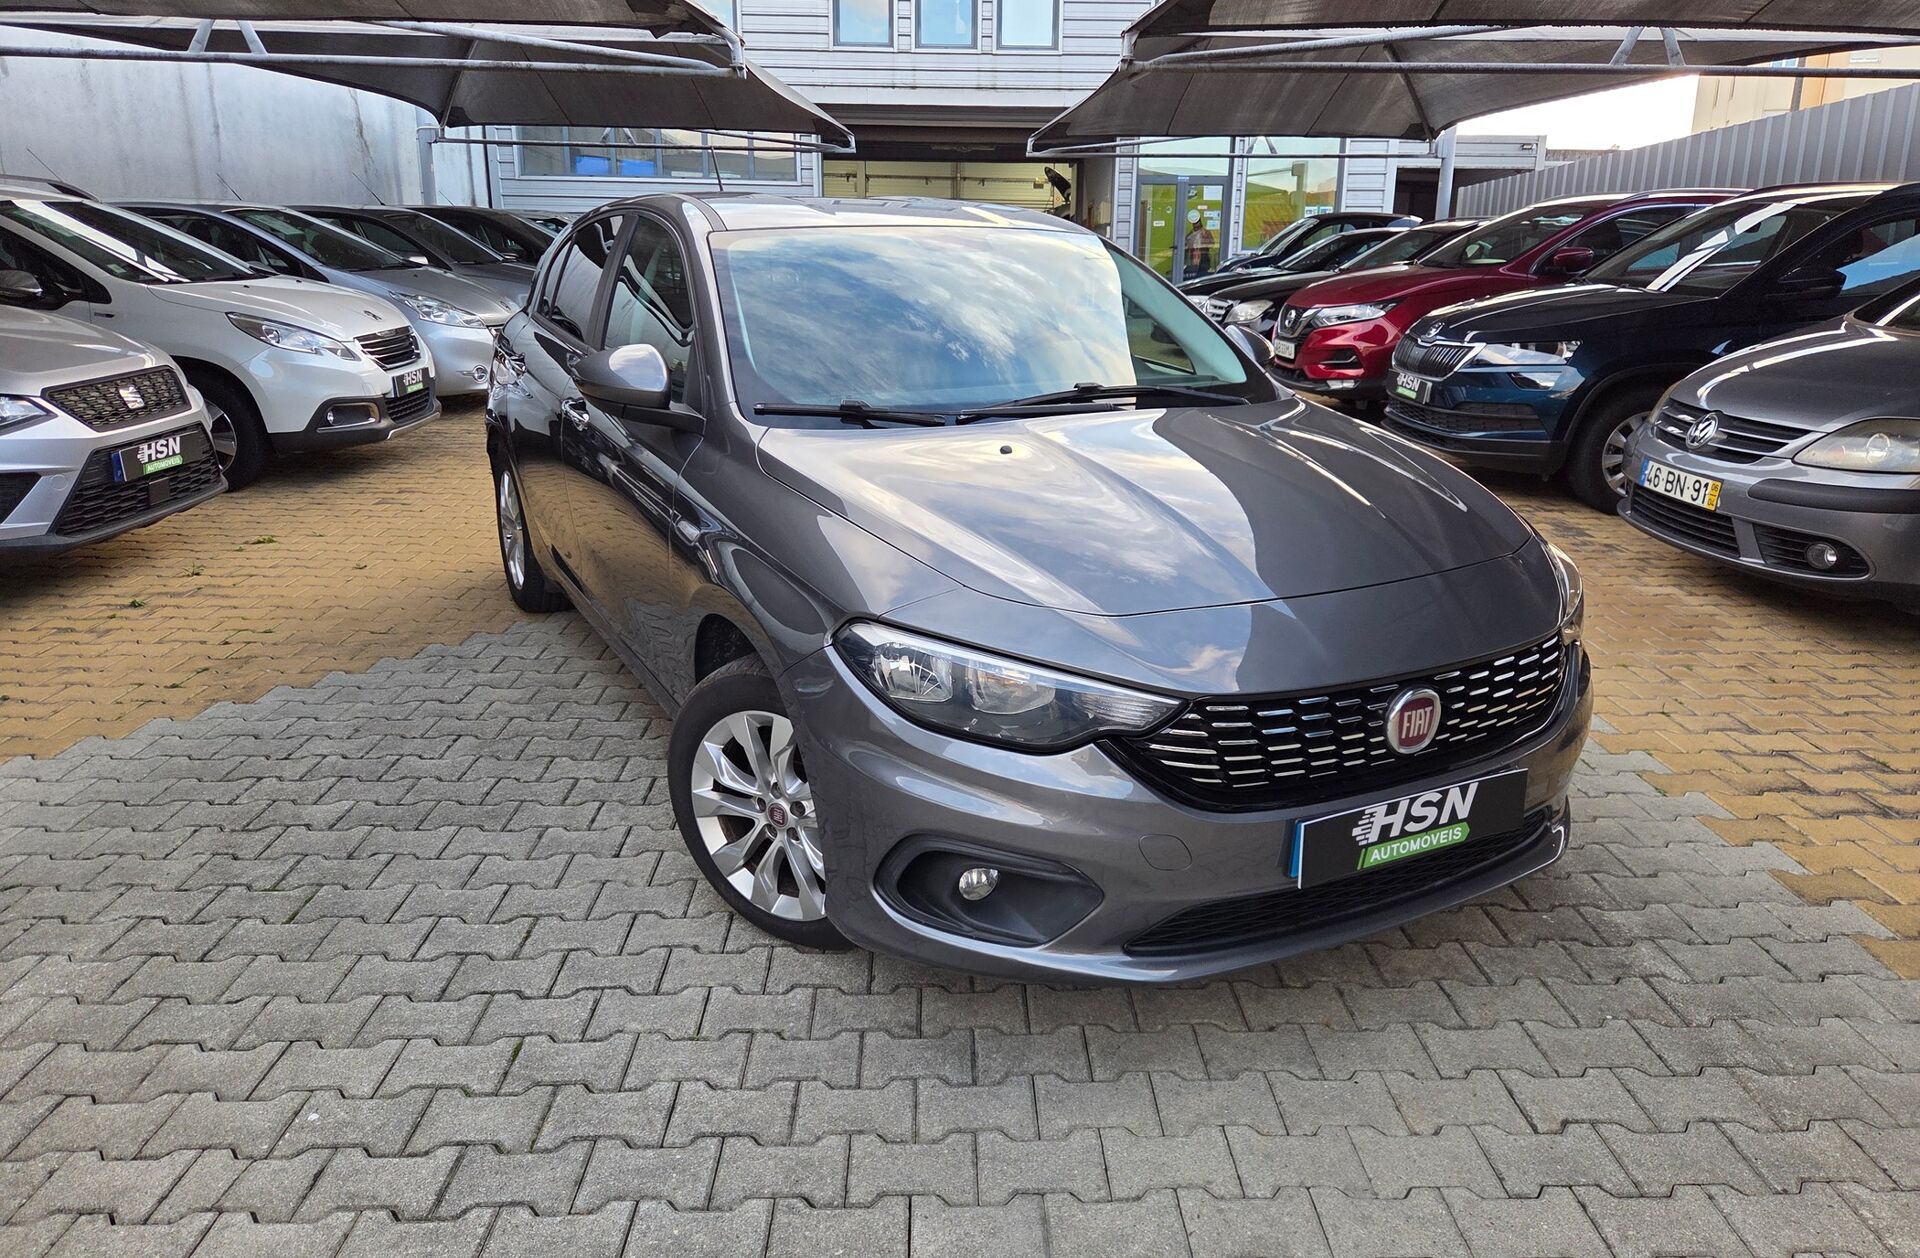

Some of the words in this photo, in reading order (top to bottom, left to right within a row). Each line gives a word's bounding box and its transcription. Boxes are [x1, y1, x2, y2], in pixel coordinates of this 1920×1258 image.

[403, 369, 423, 386] HSN
[1396, 372, 1420, 392] HSN
[137, 436, 181, 464] HSN
[1401, 706, 1433, 739] FIAT
[1352, 781, 1480, 846] HSN
